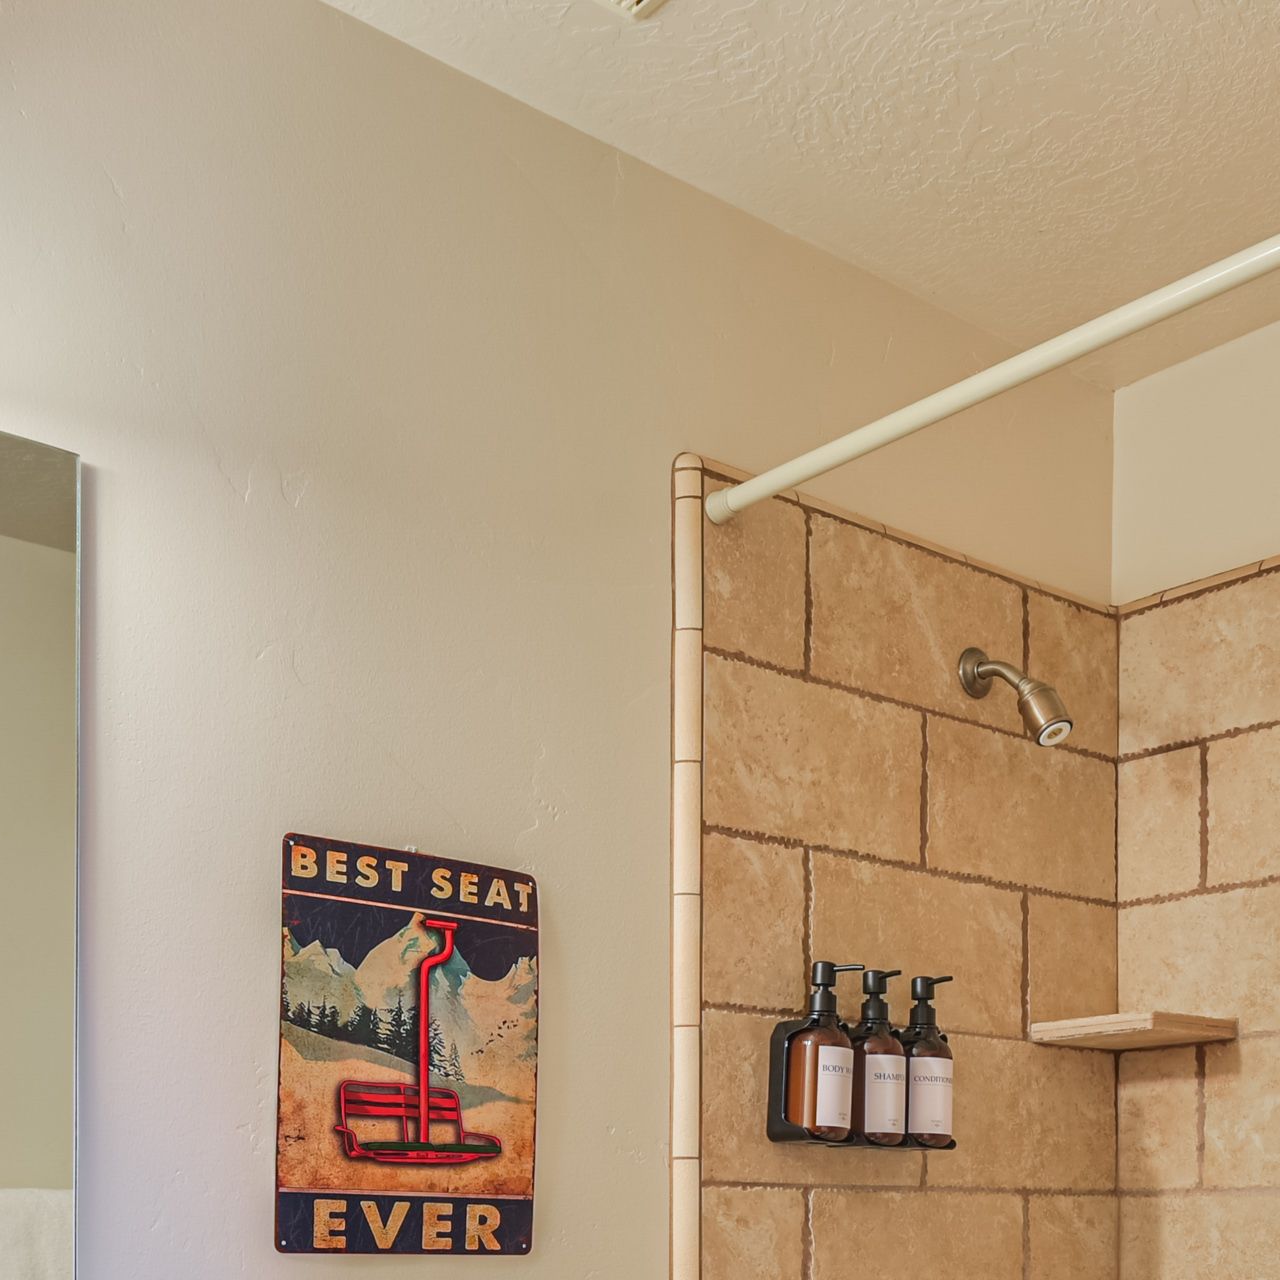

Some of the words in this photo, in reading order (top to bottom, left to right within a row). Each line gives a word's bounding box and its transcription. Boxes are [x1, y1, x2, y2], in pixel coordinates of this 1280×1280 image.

[291, 845, 409, 893] BEST
[430, 867, 533, 913] SEAT
[822, 1064, 845, 1073] BODY
[312, 1198, 502, 1251] EVER
